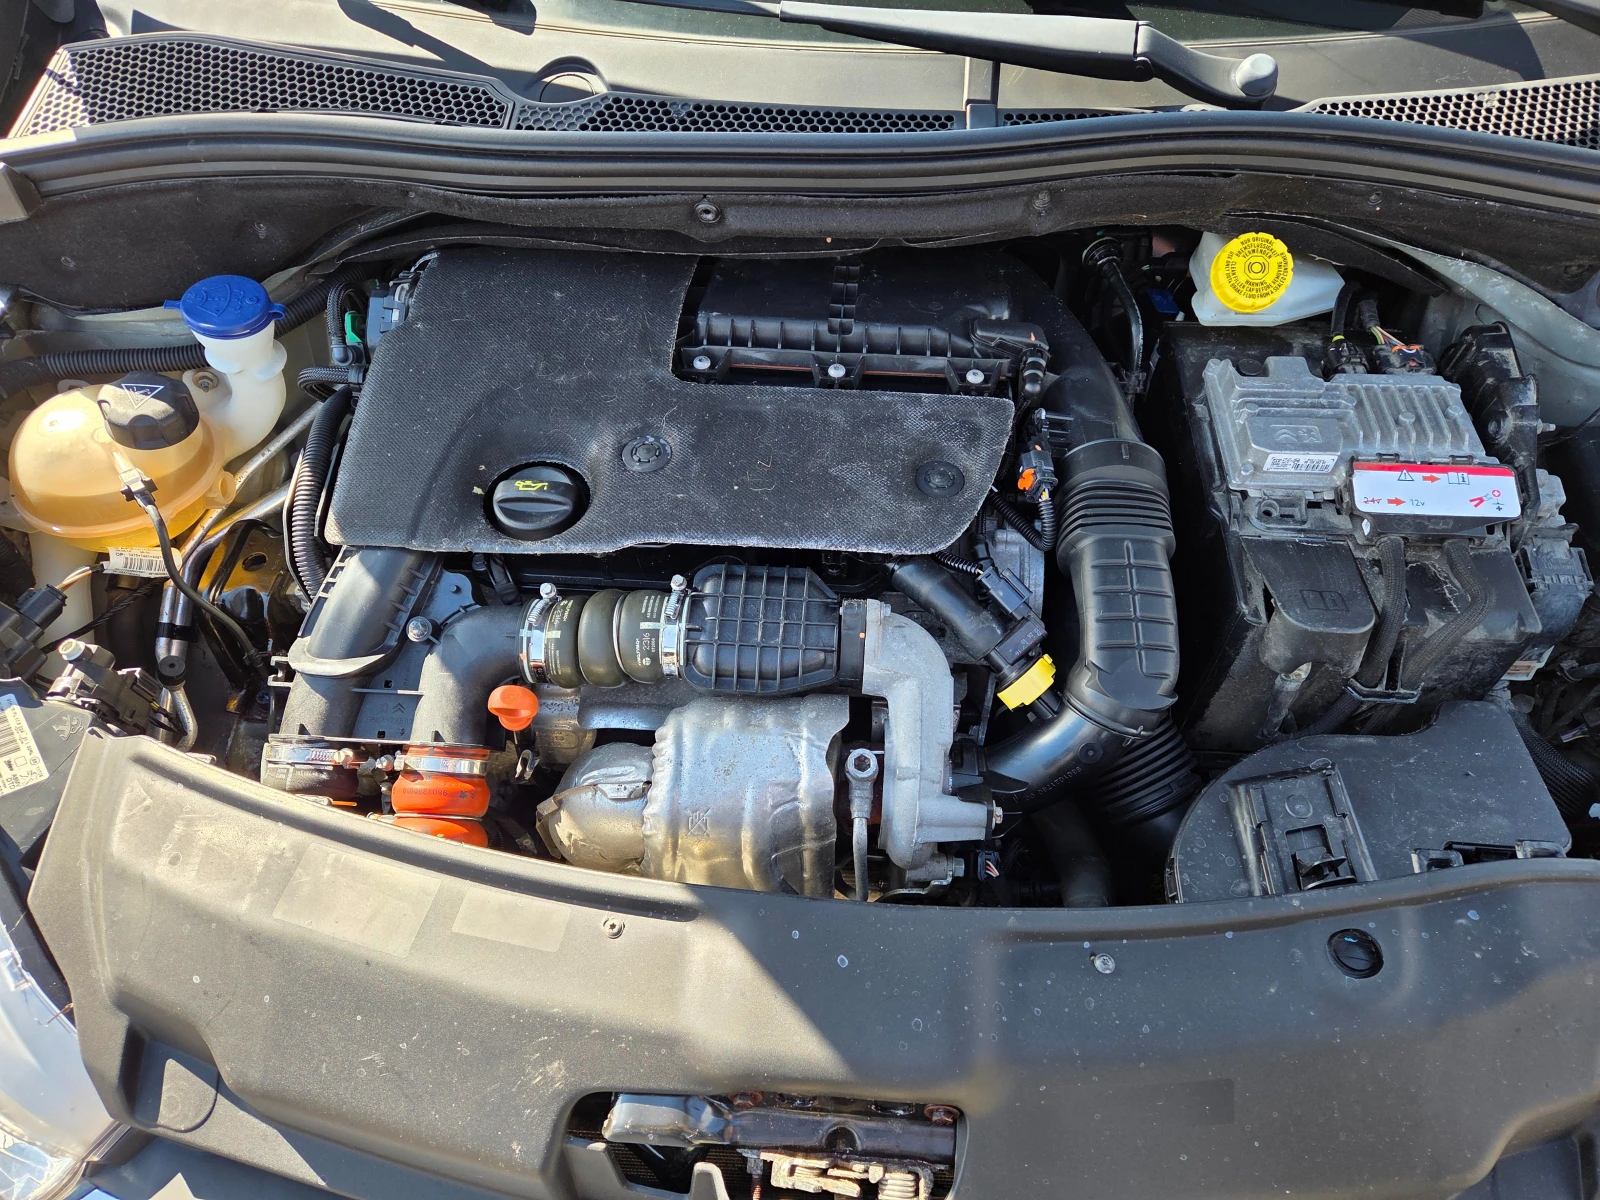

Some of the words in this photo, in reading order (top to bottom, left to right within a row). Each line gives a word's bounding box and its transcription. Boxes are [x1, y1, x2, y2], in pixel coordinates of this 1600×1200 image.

[1240, 238, 1250, 246] NUR
[1252, 237, 1274, 246] ORIGINAL
[1242, 248, 1272, 259] VERWENDEN
[1233, 275, 1246, 288] FILLER
[1256, 283, 1273, 292] BEFORE
[1273, 261, 1282, 285] REMOVING
[1245, 279, 1267, 287] WARNING
[1230, 283, 1244, 295] BRAKE
[1274, 276, 1286, 292] SEALED
[642, 632, 650, 650] 2316
